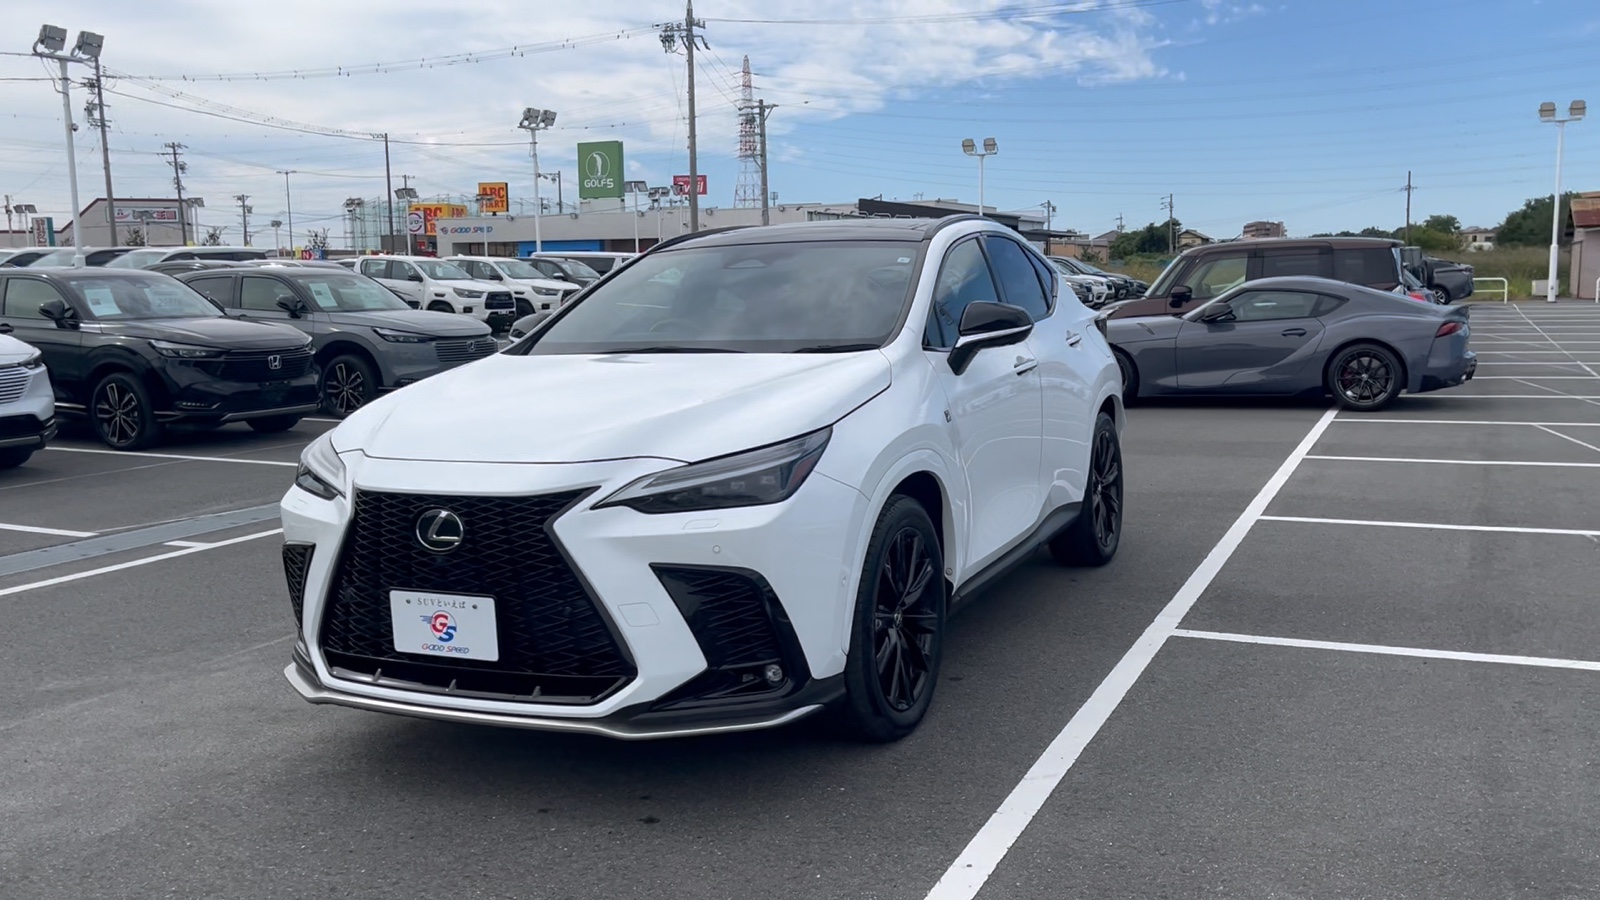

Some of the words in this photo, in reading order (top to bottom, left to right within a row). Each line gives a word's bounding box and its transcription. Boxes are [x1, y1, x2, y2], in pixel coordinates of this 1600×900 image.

[584, 178, 614, 188] GOLF5
[482, 187, 505, 198] ABC
[418, 598, 466, 609] SUVといえば
[422, 643, 445, 651] GOOD
[446, 645, 470, 654] SPEED
